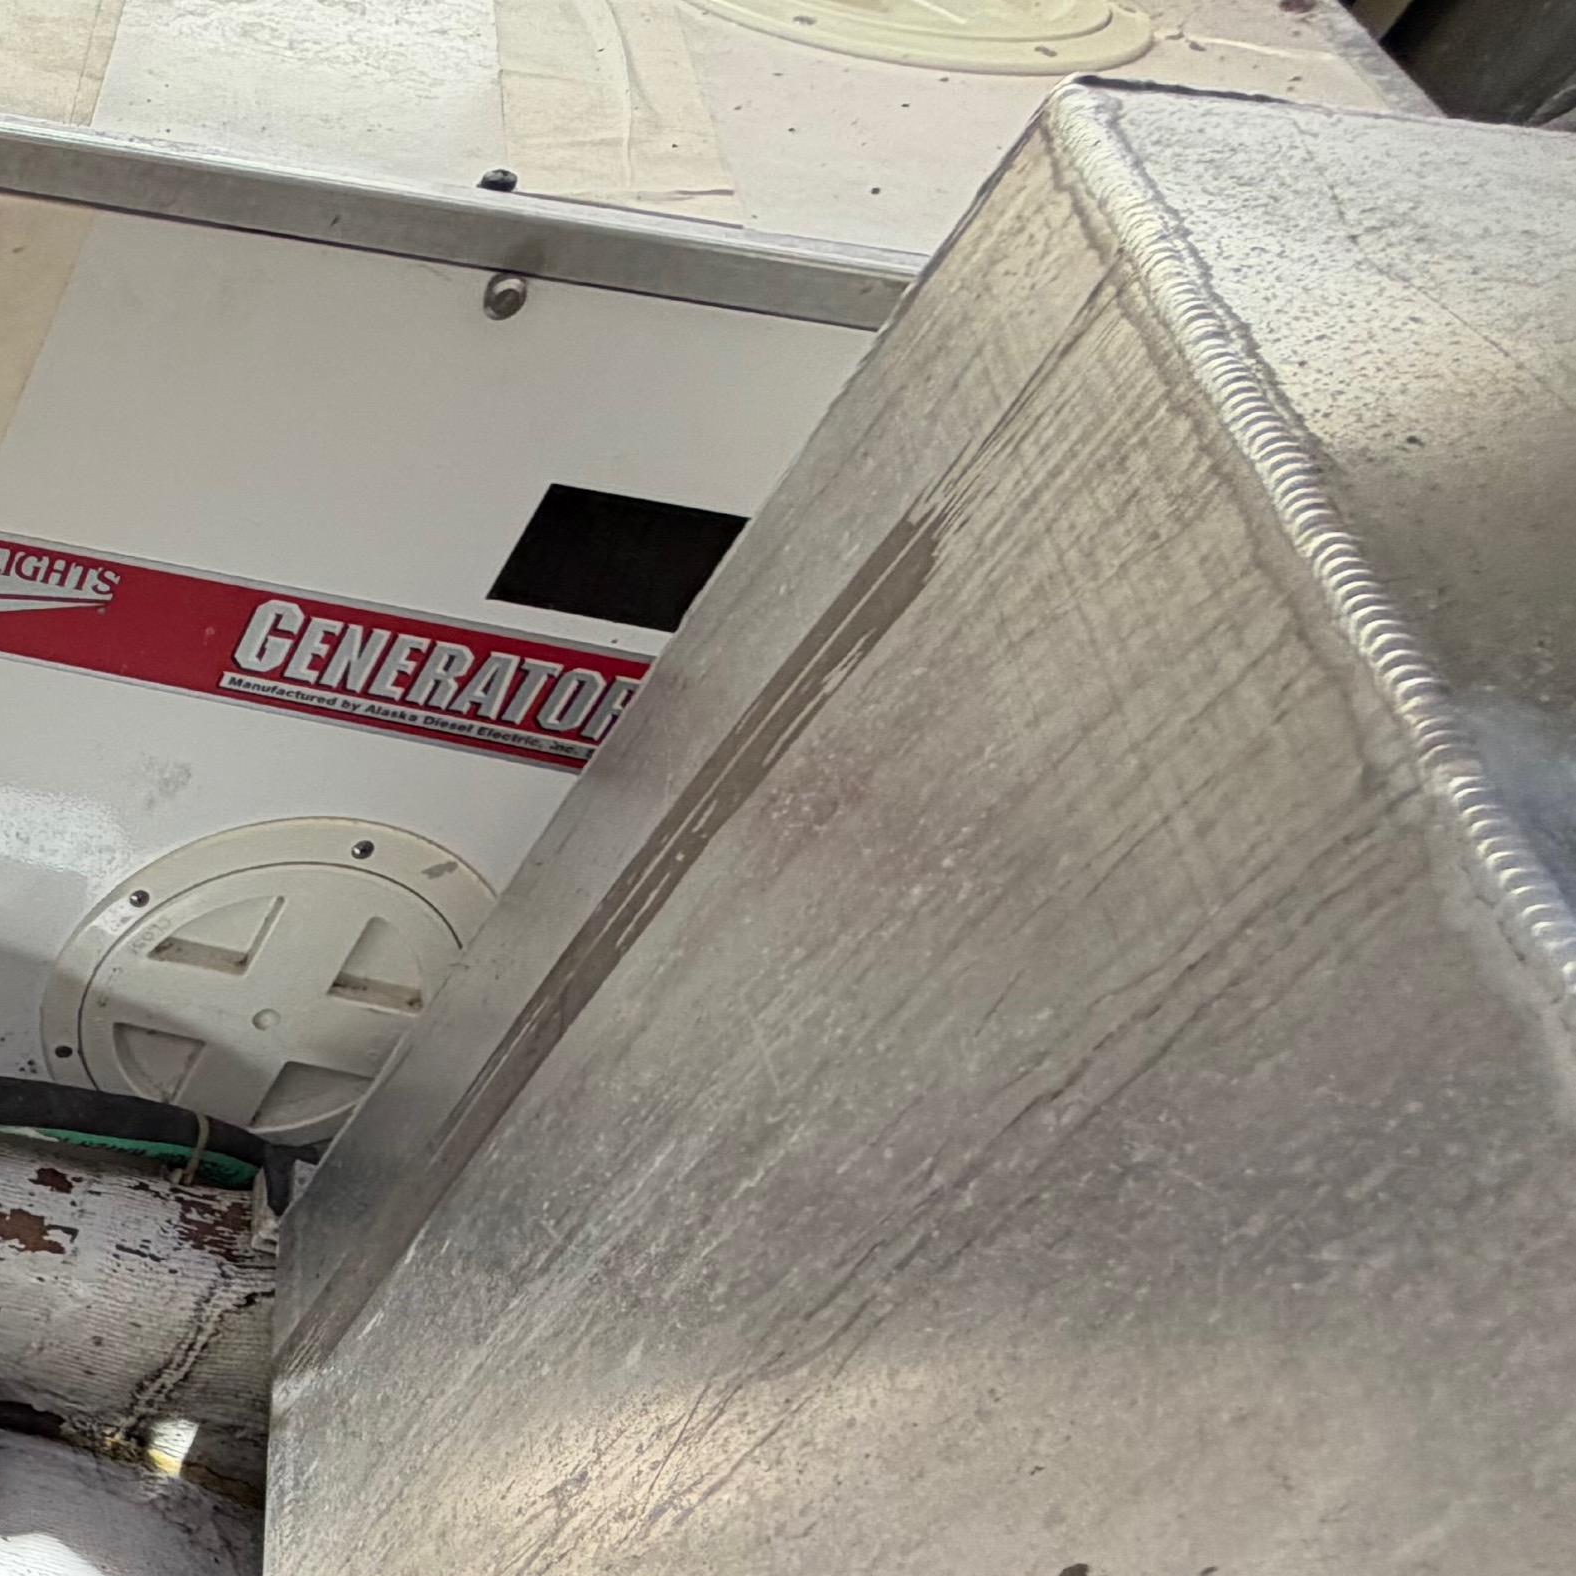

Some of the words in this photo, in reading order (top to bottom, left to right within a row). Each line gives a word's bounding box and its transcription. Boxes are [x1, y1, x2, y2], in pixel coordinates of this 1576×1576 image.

[227, 675, 337, 707] Manufactured
[340, 699, 361, 713] by
[364, 703, 417, 723] Alaska
[422, 714, 473, 734] Diesel
